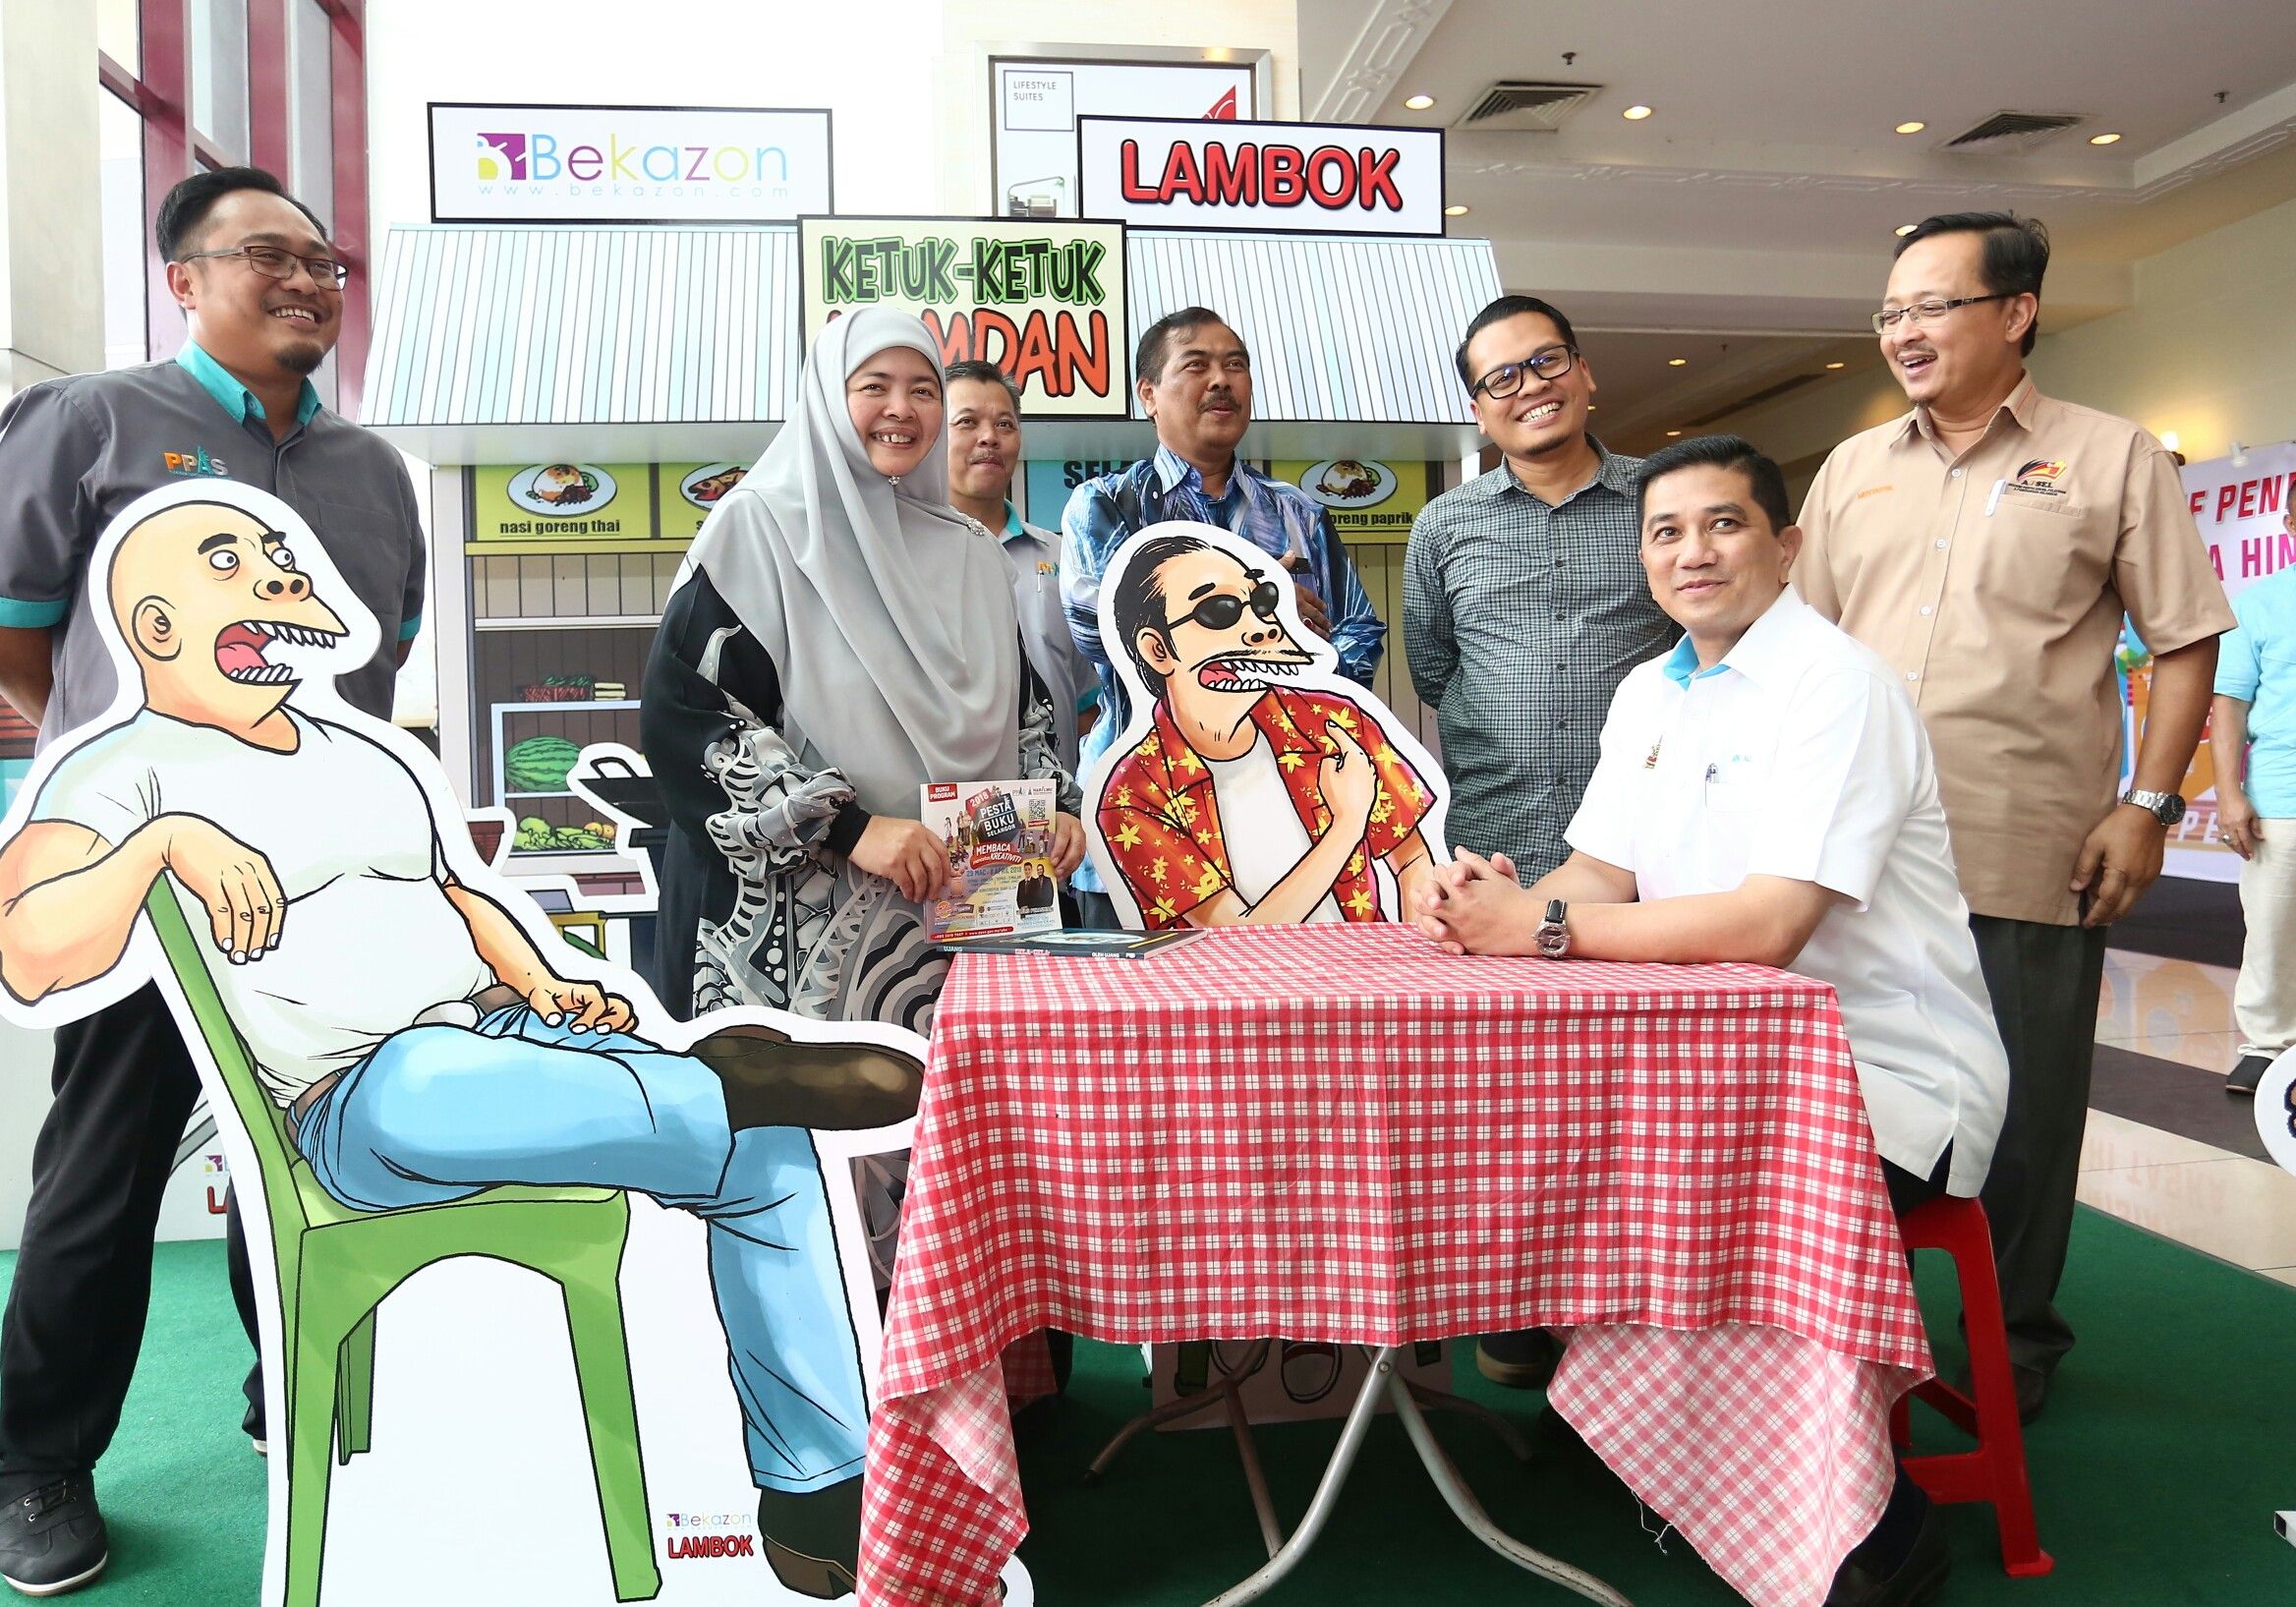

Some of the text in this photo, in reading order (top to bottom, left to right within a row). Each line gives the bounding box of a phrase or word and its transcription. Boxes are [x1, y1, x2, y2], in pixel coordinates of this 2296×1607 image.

[1013, 81, 1057, 89] LIFESTYLE
[1013, 92, 1044, 101] SUITES
[532, 133, 787, 181] Bekazon
[1120, 139, 1403, 211] LAMBOK
[479, 183, 788, 198] www.bekazon.com
[821, 235, 1106, 306] KETUK-KETUK
[827, 308, 1110, 398] MDAN
[163, 445, 228, 476] PPAS
[2215, 472, 2296, 523] PEN
[1371, 512, 1413, 525] paprik
[499, 520, 620, 536] nasi goreng thai
[930, 791, 956, 800] PROGRAM
[969, 792, 990, 807] 2018
[980, 797, 1012, 819] PESTA
[984, 813, 1015, 832] BUKU
[987, 824, 1016, 837] SELANGOR
[976, 843, 1010, 857] MEMBACA
[991, 851, 1022, 864] KREATIVITI
[680, 1512, 752, 1526] Bekazon
[667, 1534, 754, 1559] LAMBOK
